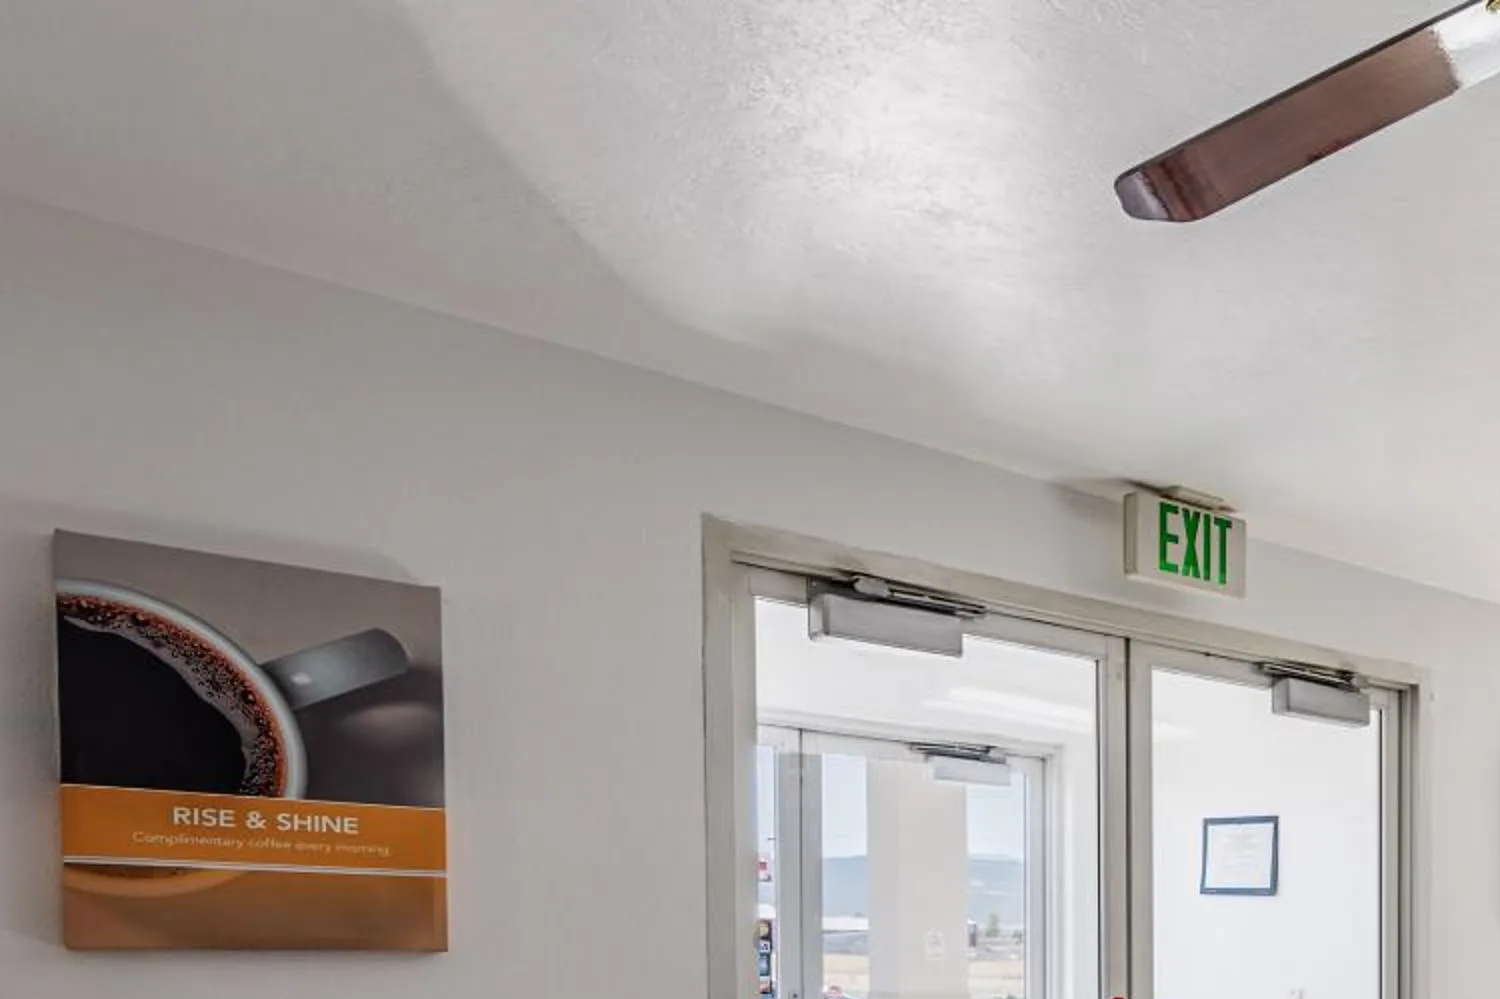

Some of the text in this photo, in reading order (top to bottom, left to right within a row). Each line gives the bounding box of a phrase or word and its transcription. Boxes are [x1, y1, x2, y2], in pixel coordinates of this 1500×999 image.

[1159, 501, 1232, 585] EXIT
[173, 806, 359, 835] RISE & SHINE
[132, 830, 390, 857] Complimentary coffee every morning
